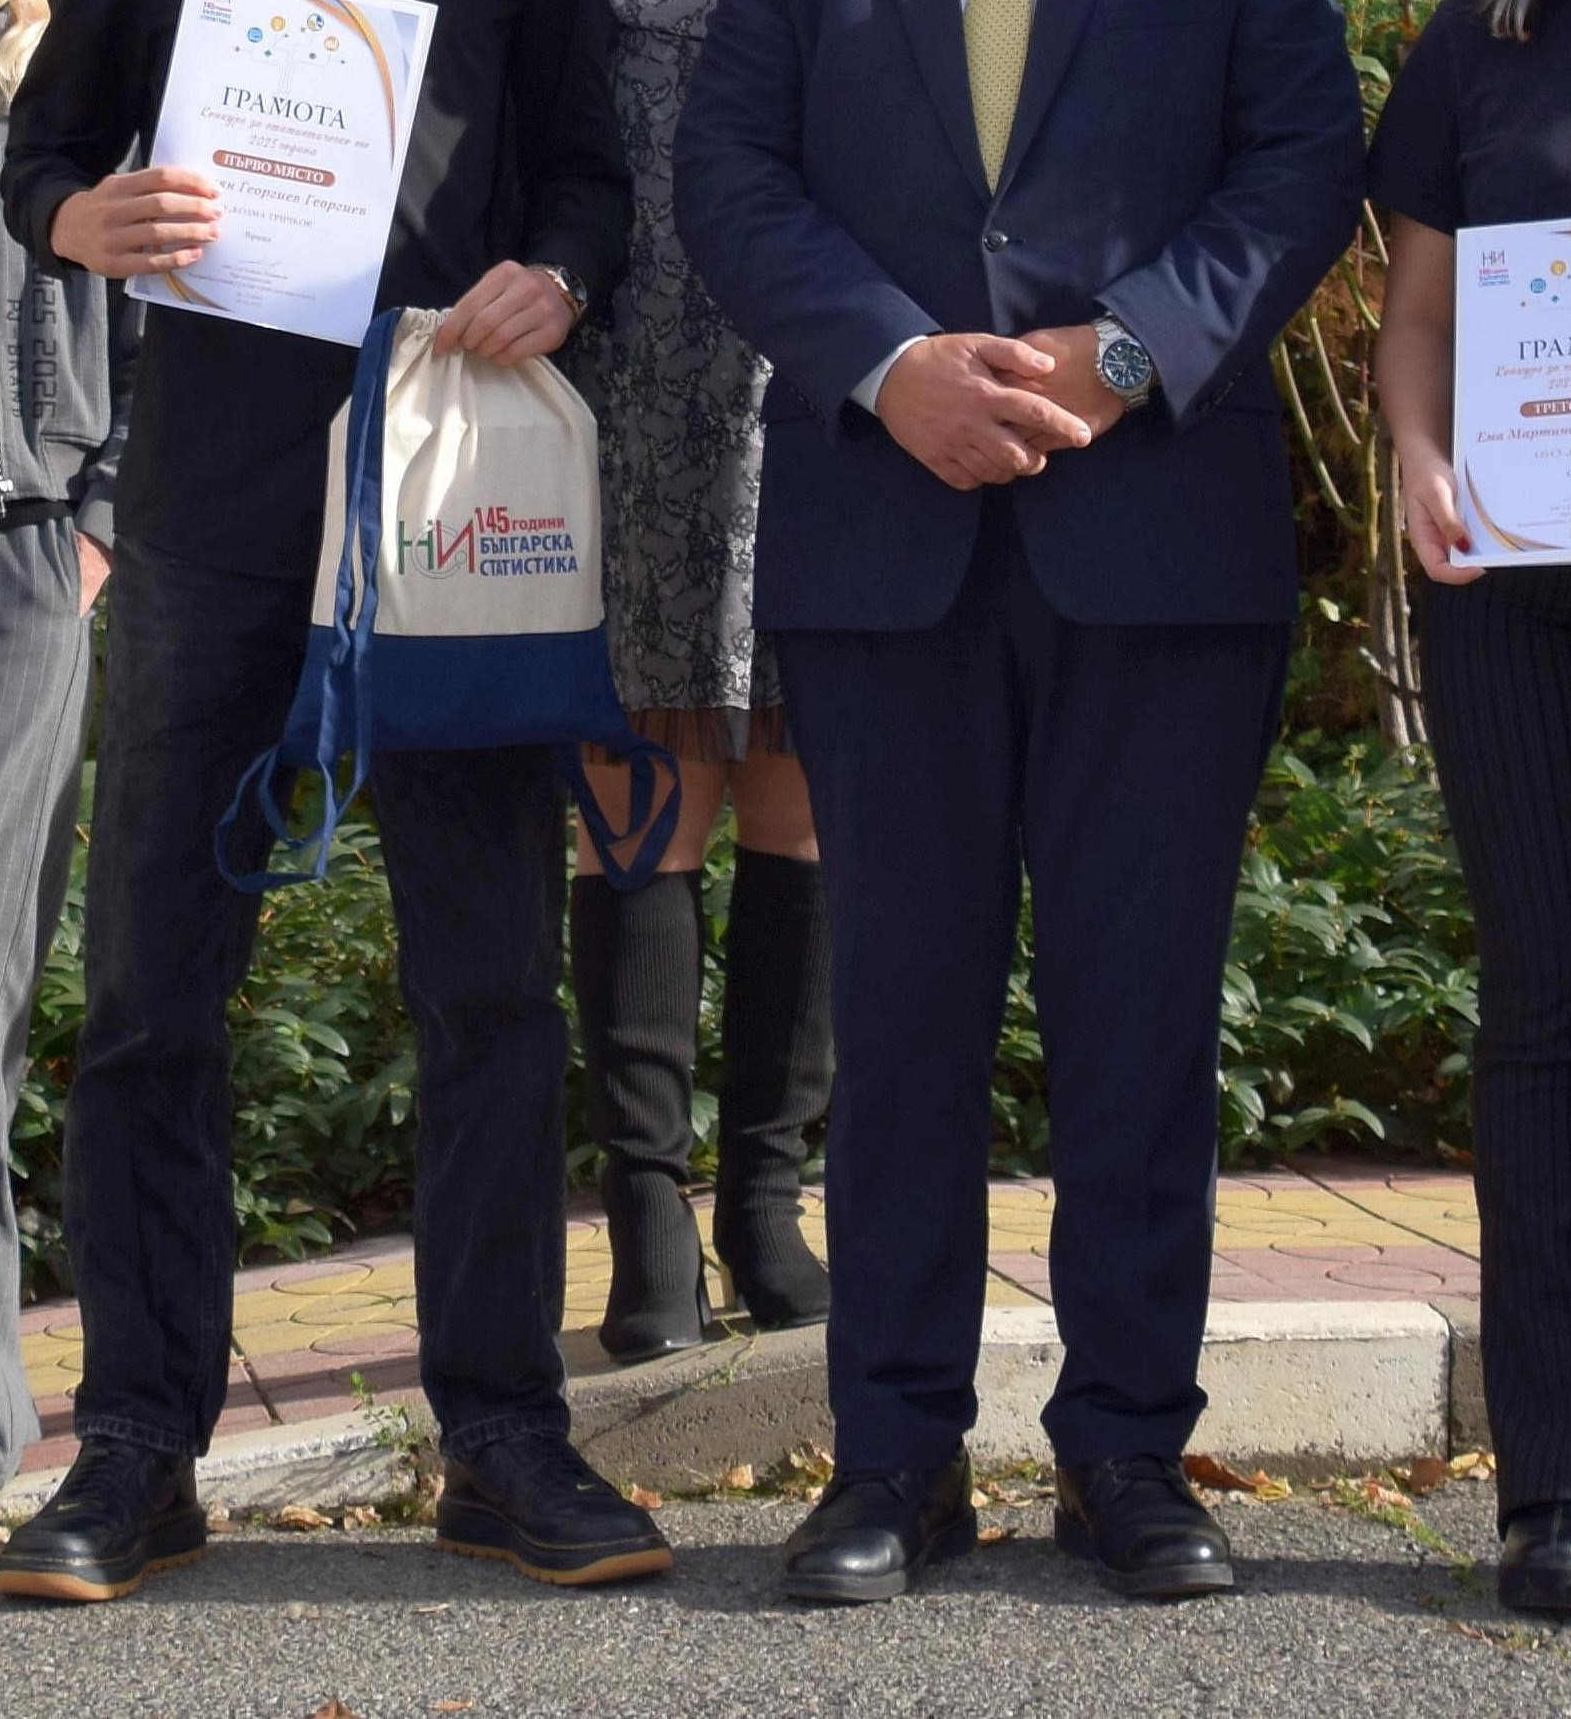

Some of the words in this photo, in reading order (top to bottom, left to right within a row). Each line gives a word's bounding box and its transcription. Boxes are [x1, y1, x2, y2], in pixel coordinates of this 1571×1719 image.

[222, 86, 347, 130] ГРАМОТА
[248, 134, 278, 149] 2025
[223, 154, 272, 173] ПЪРВО
[274, 163, 325, 184] МЯСТО
[238, 181, 301, 204] Георгиев
[304, 195, 368, 217] Георгиев
[1477, 431, 1504, 444] Ема
[475, 505, 510, 534] 145
[512, 517, 566, 532] години
[480, 534, 574, 555] БЪЛГАРСКА
[480, 555, 579, 577] СТАТИСТИКА
